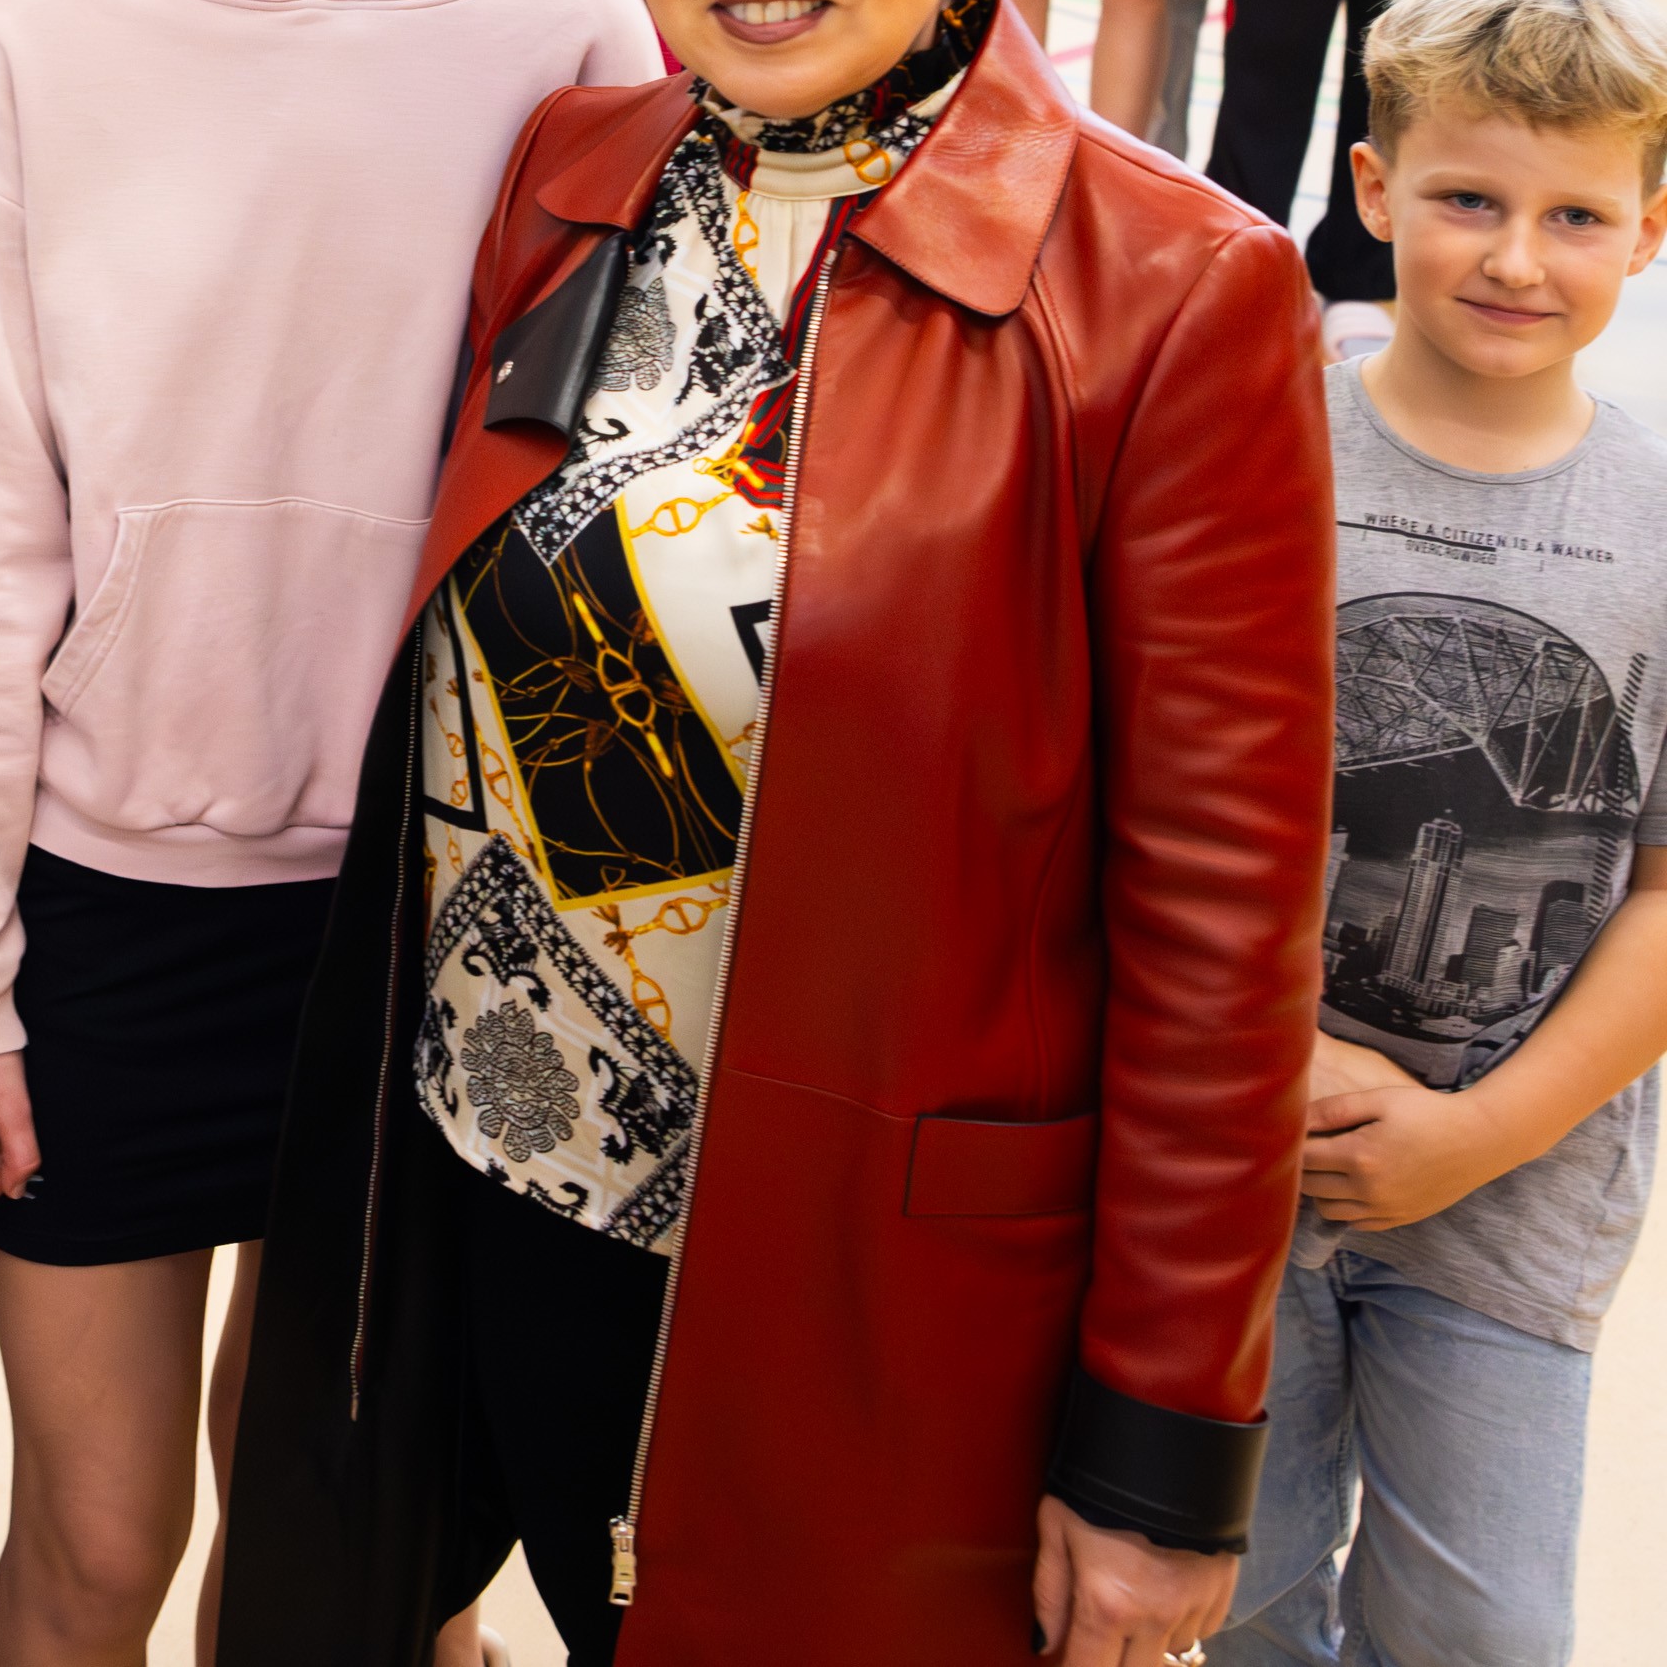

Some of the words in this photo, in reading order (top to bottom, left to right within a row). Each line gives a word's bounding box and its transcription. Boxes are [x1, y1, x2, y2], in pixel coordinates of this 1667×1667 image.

[1364, 512, 1420, 533] WHERE
[1425, 523, 1436, 536] A
[1442, 526, 1506, 548] CITIZEN
[1513, 536, 1528, 551] IS
[1534, 541, 1545, 554] A
[1551, 542, 1615, 564] WALKER
